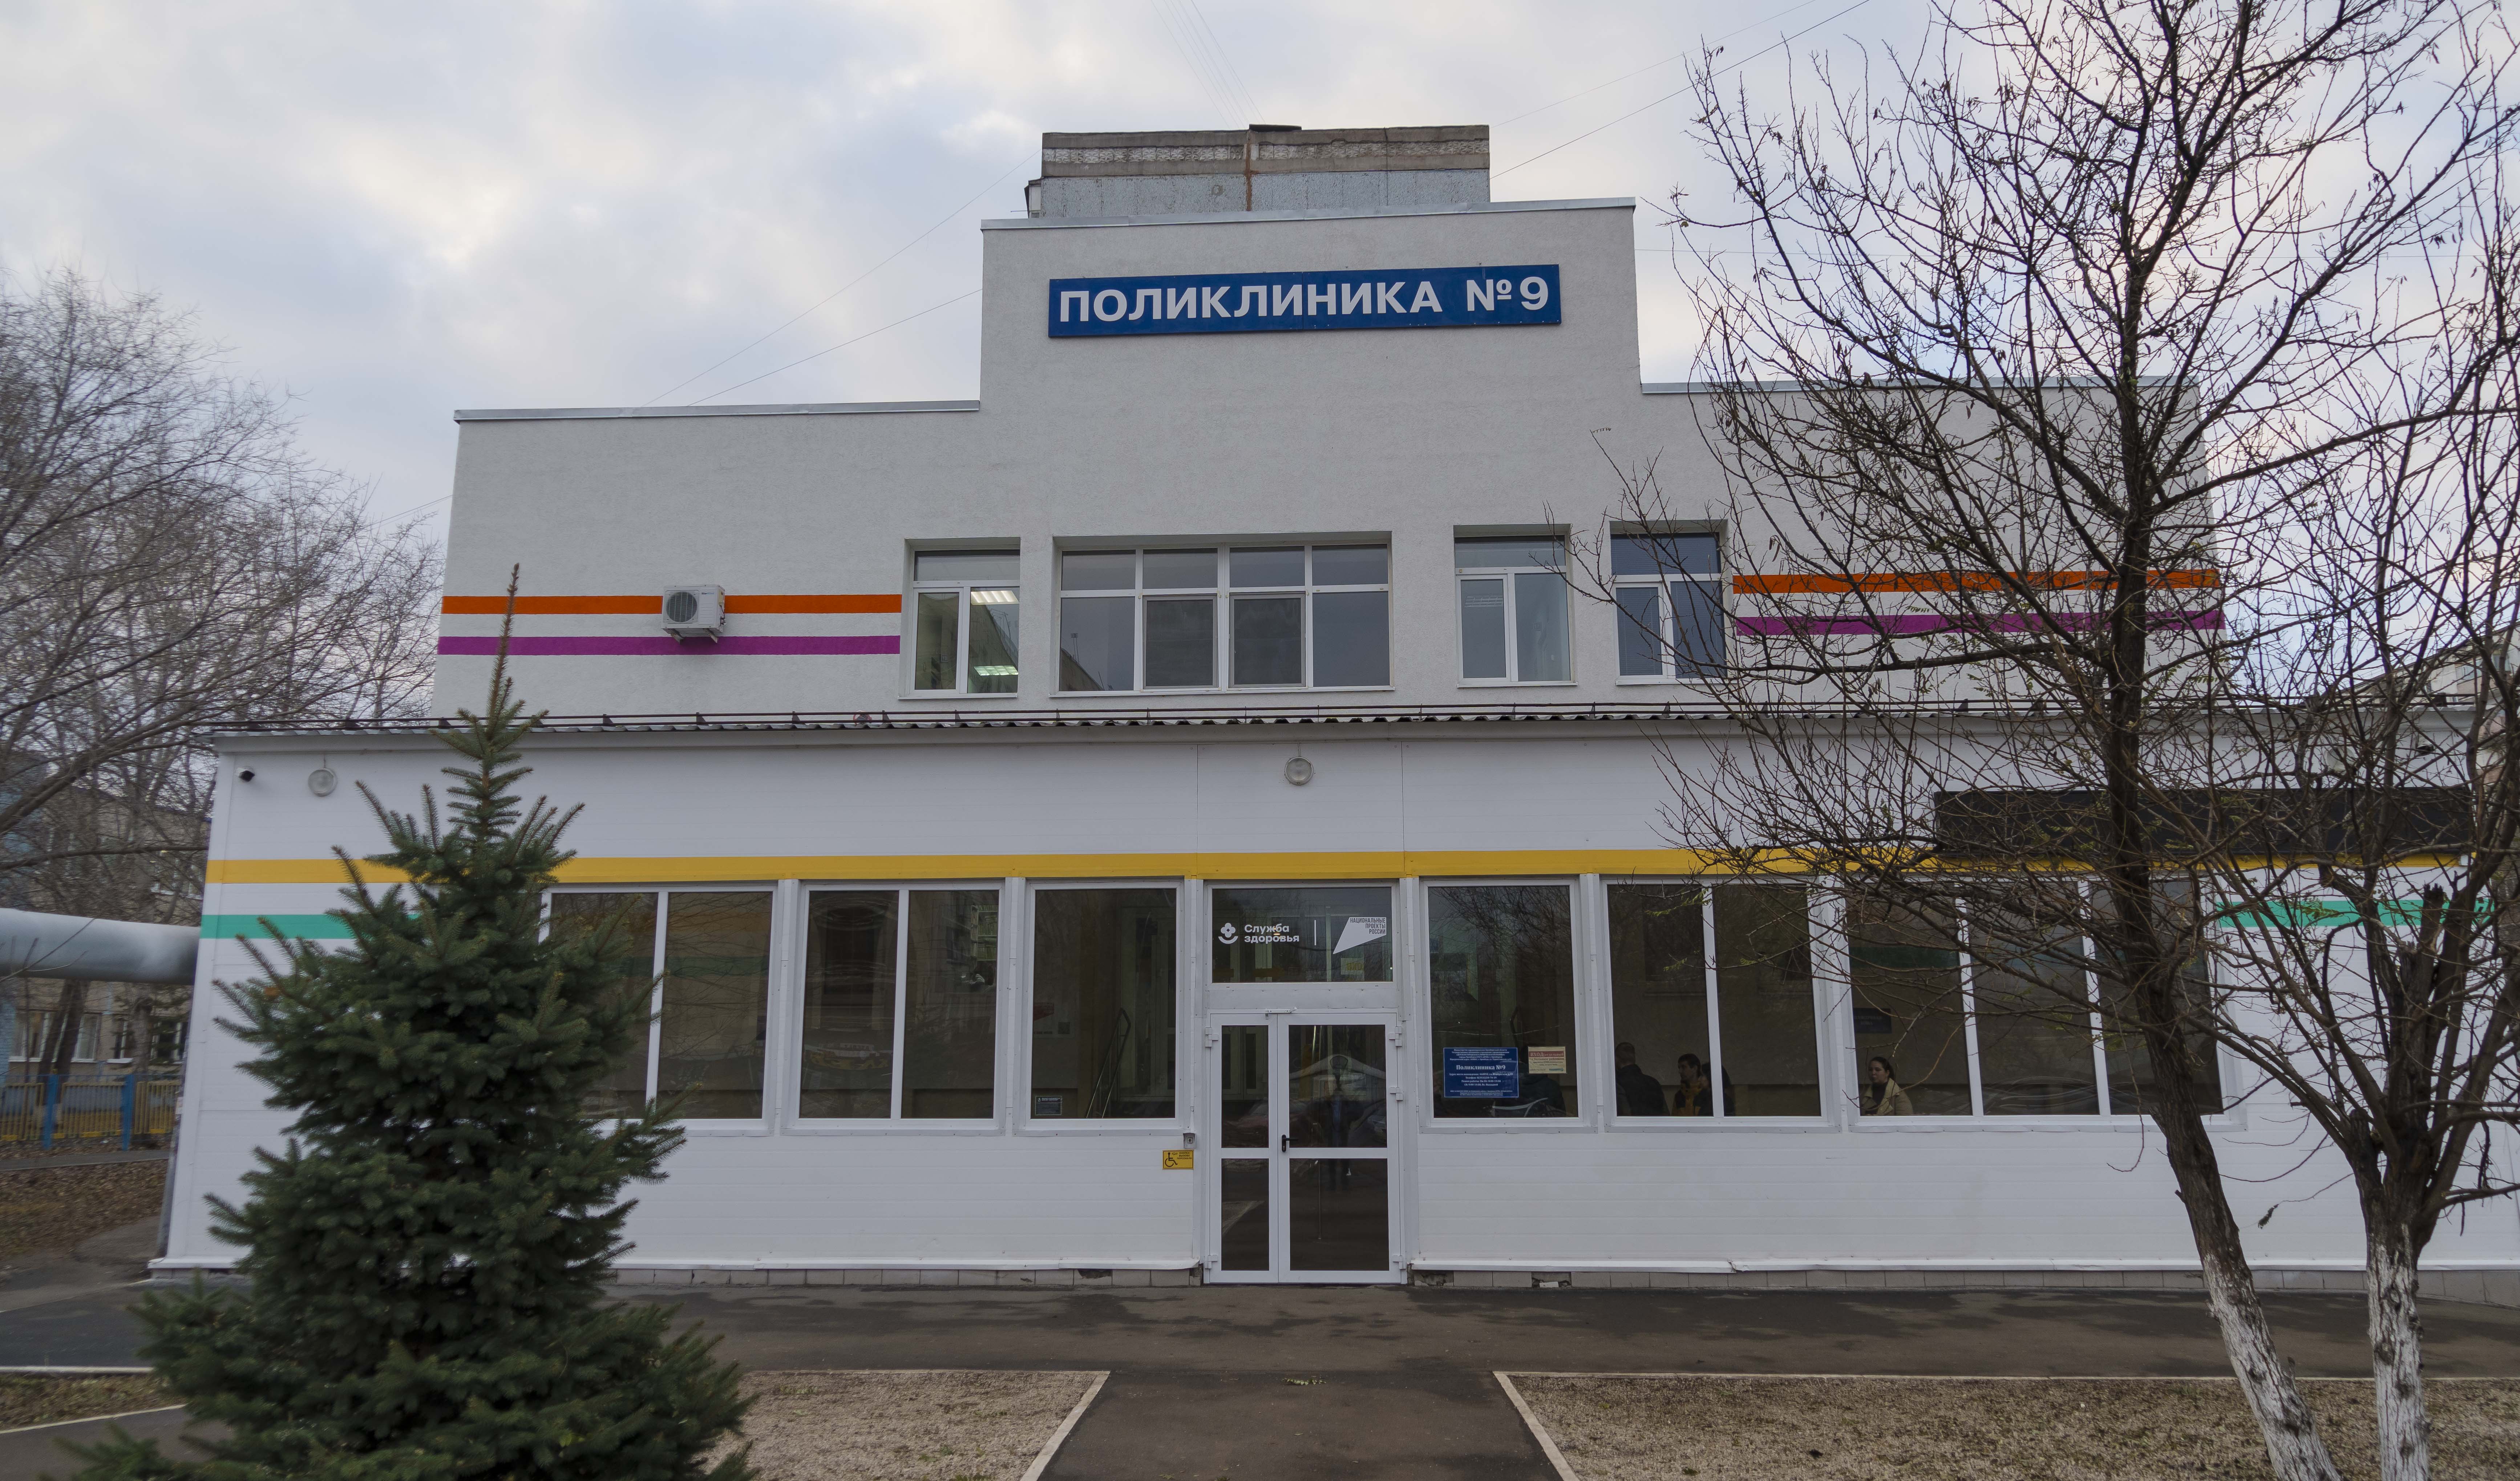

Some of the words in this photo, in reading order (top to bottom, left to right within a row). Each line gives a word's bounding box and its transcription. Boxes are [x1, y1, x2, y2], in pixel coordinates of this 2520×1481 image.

[1060, 281, 1443, 322] ПОЛИКЛИНИКА
[1467, 276, 1548, 312] №9
[1244, 924, 1289, 934] Служба
[1244, 935, 1299, 944] здоровья
